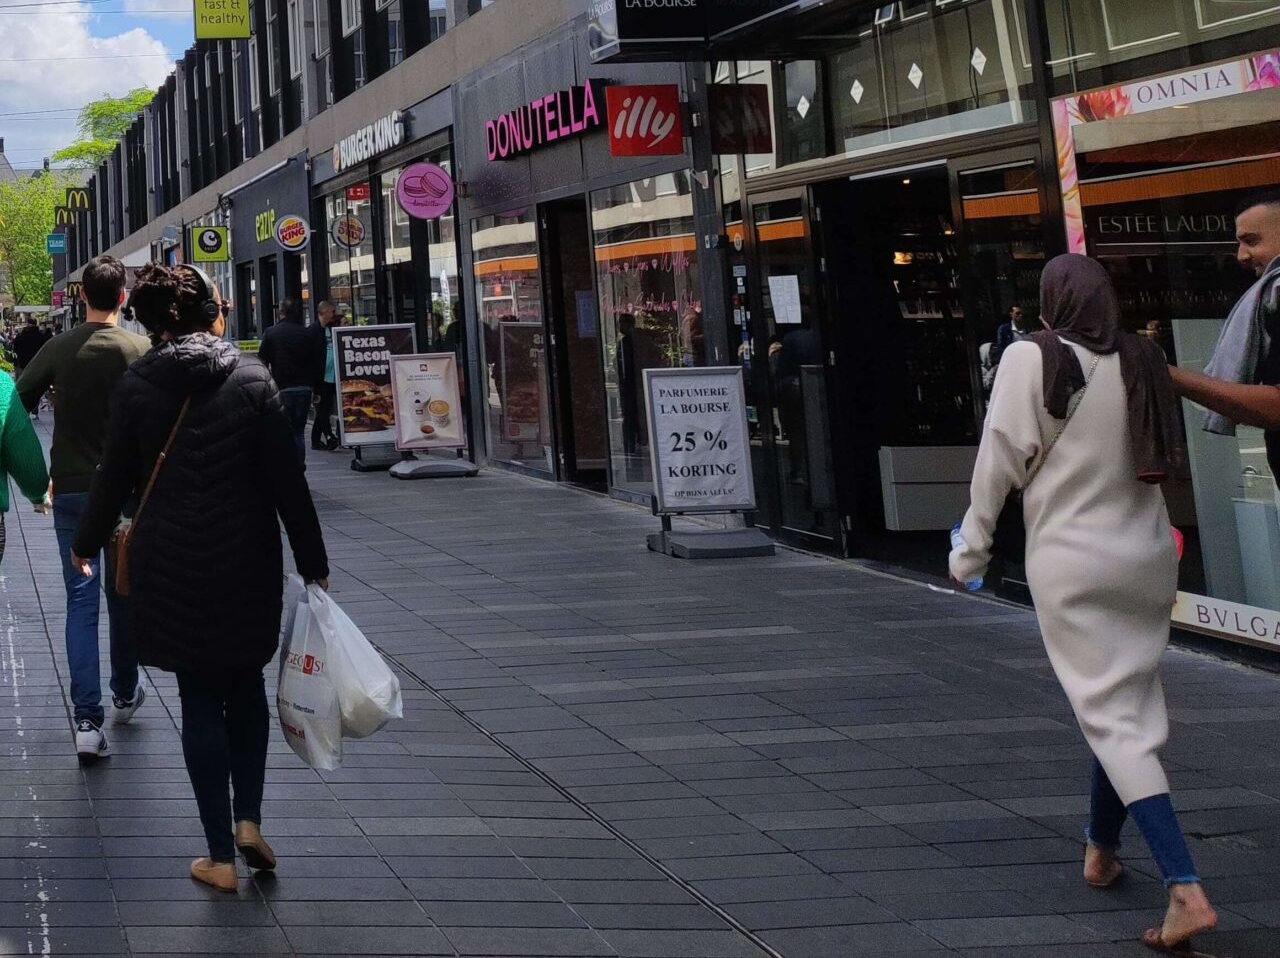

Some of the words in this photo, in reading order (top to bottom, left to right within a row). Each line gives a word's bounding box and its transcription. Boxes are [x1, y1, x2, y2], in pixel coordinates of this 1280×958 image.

[200, 12, 245, 26] healthy
[1137, 69, 1232, 103] OMNIA
[485, 78, 599, 162] DONUTELLA
[614, 96, 675, 148] illy
[340, 125, 375, 171] BURGER
[374, 110, 402, 154] KING
[279, 221, 303, 235] BURGER
[1165, 214, 1232, 233] LAUDE
[281, 228, 305, 242] KING
[342, 335, 386, 349] Texas
[344, 350, 391, 363] Bacon
[345, 363, 390, 377] Lover
[659, 387, 729, 398] PARFUMERIE
[660, 404, 679, 414] LA
[681, 402, 731, 414] BOURSE
[670, 431, 696, 452] 25
[704, 430, 728, 451] %
[668, 463, 737, 478] KORTING
